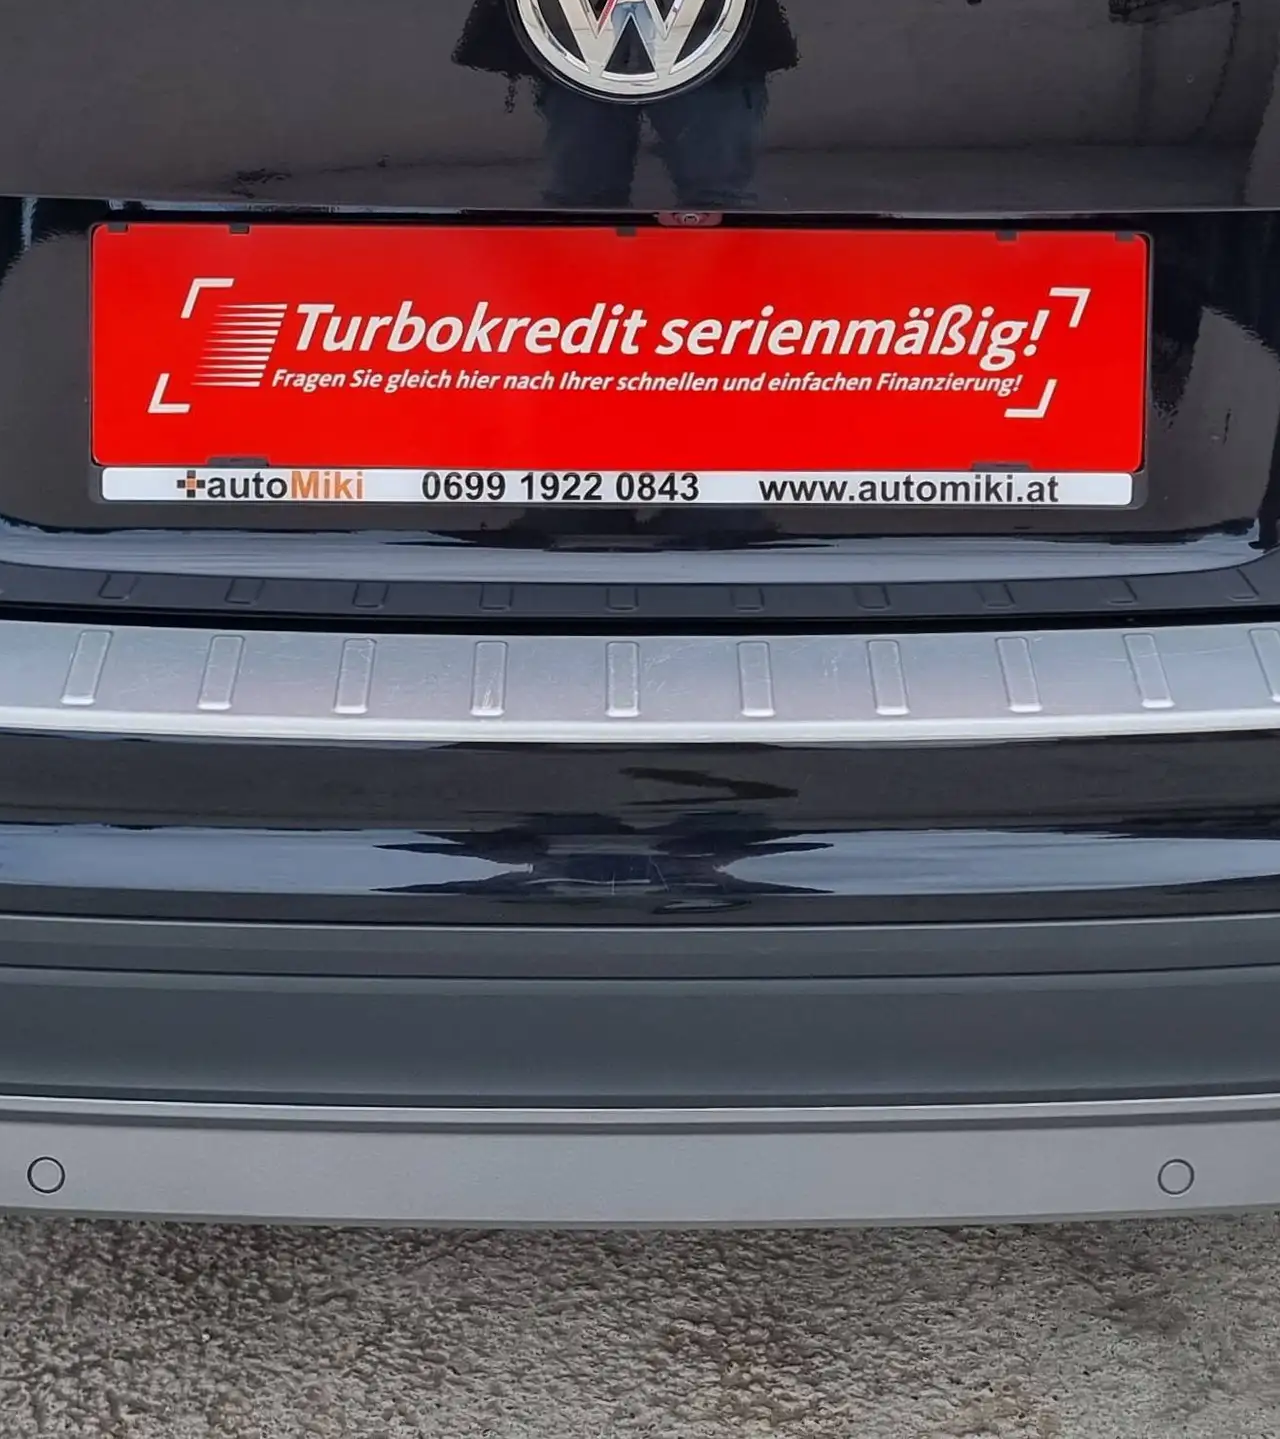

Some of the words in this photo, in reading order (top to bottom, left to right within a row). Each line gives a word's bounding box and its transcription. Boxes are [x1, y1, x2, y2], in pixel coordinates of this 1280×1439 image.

[296, 300, 648, 355] Turbokredit
[655, 304, 1050, 372] serienmäßig!
[271, 368, 346, 393] Fragen
[350, 368, 383, 389] Sie
[384, 369, 452, 394] gleich
[455, 369, 501, 390] hier
[503, 370, 555, 391] nach
[559, 371, 615, 391] Ihrer
[616, 371, 719, 392] schnellen
[722, 372, 767, 392] und
[768, 372, 873, 392] einfachen
[876, 372, 1023, 397] Finanzierung!
[207, 471, 364, 499] autoMiki
[422, 471, 506, 501] 0699
[520, 471, 603, 501] 1922
[615, 472, 700, 502] 0843
[758, 474, 1060, 502] www.automiki.at
